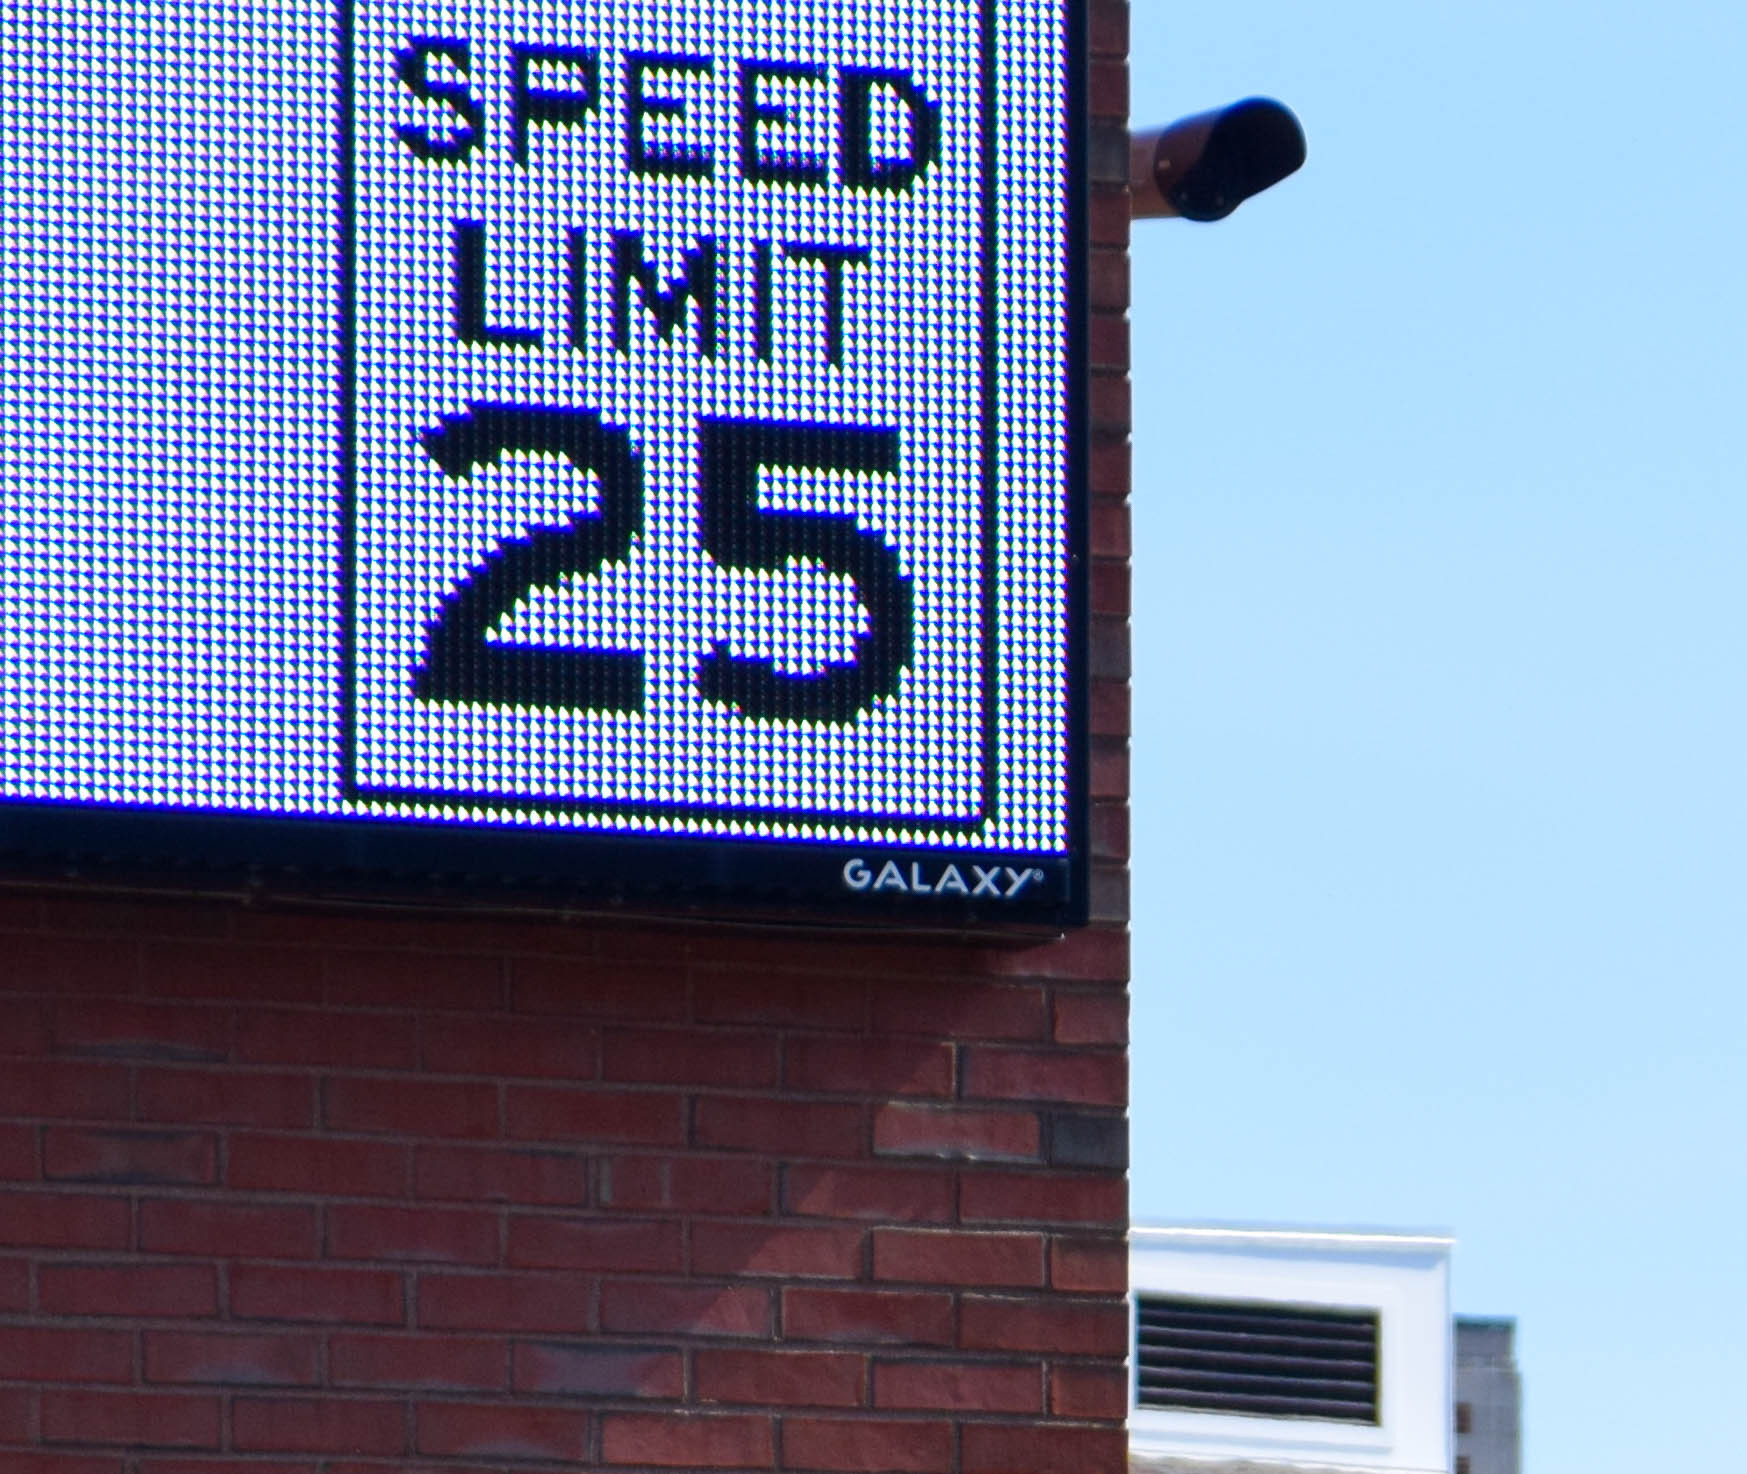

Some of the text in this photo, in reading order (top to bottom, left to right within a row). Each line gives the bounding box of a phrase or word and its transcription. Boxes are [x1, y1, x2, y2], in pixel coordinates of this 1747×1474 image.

[397, 35, 942, 193] SPEED
[454, 217, 872, 366] LIMIT
[413, 403, 915, 725] 25
